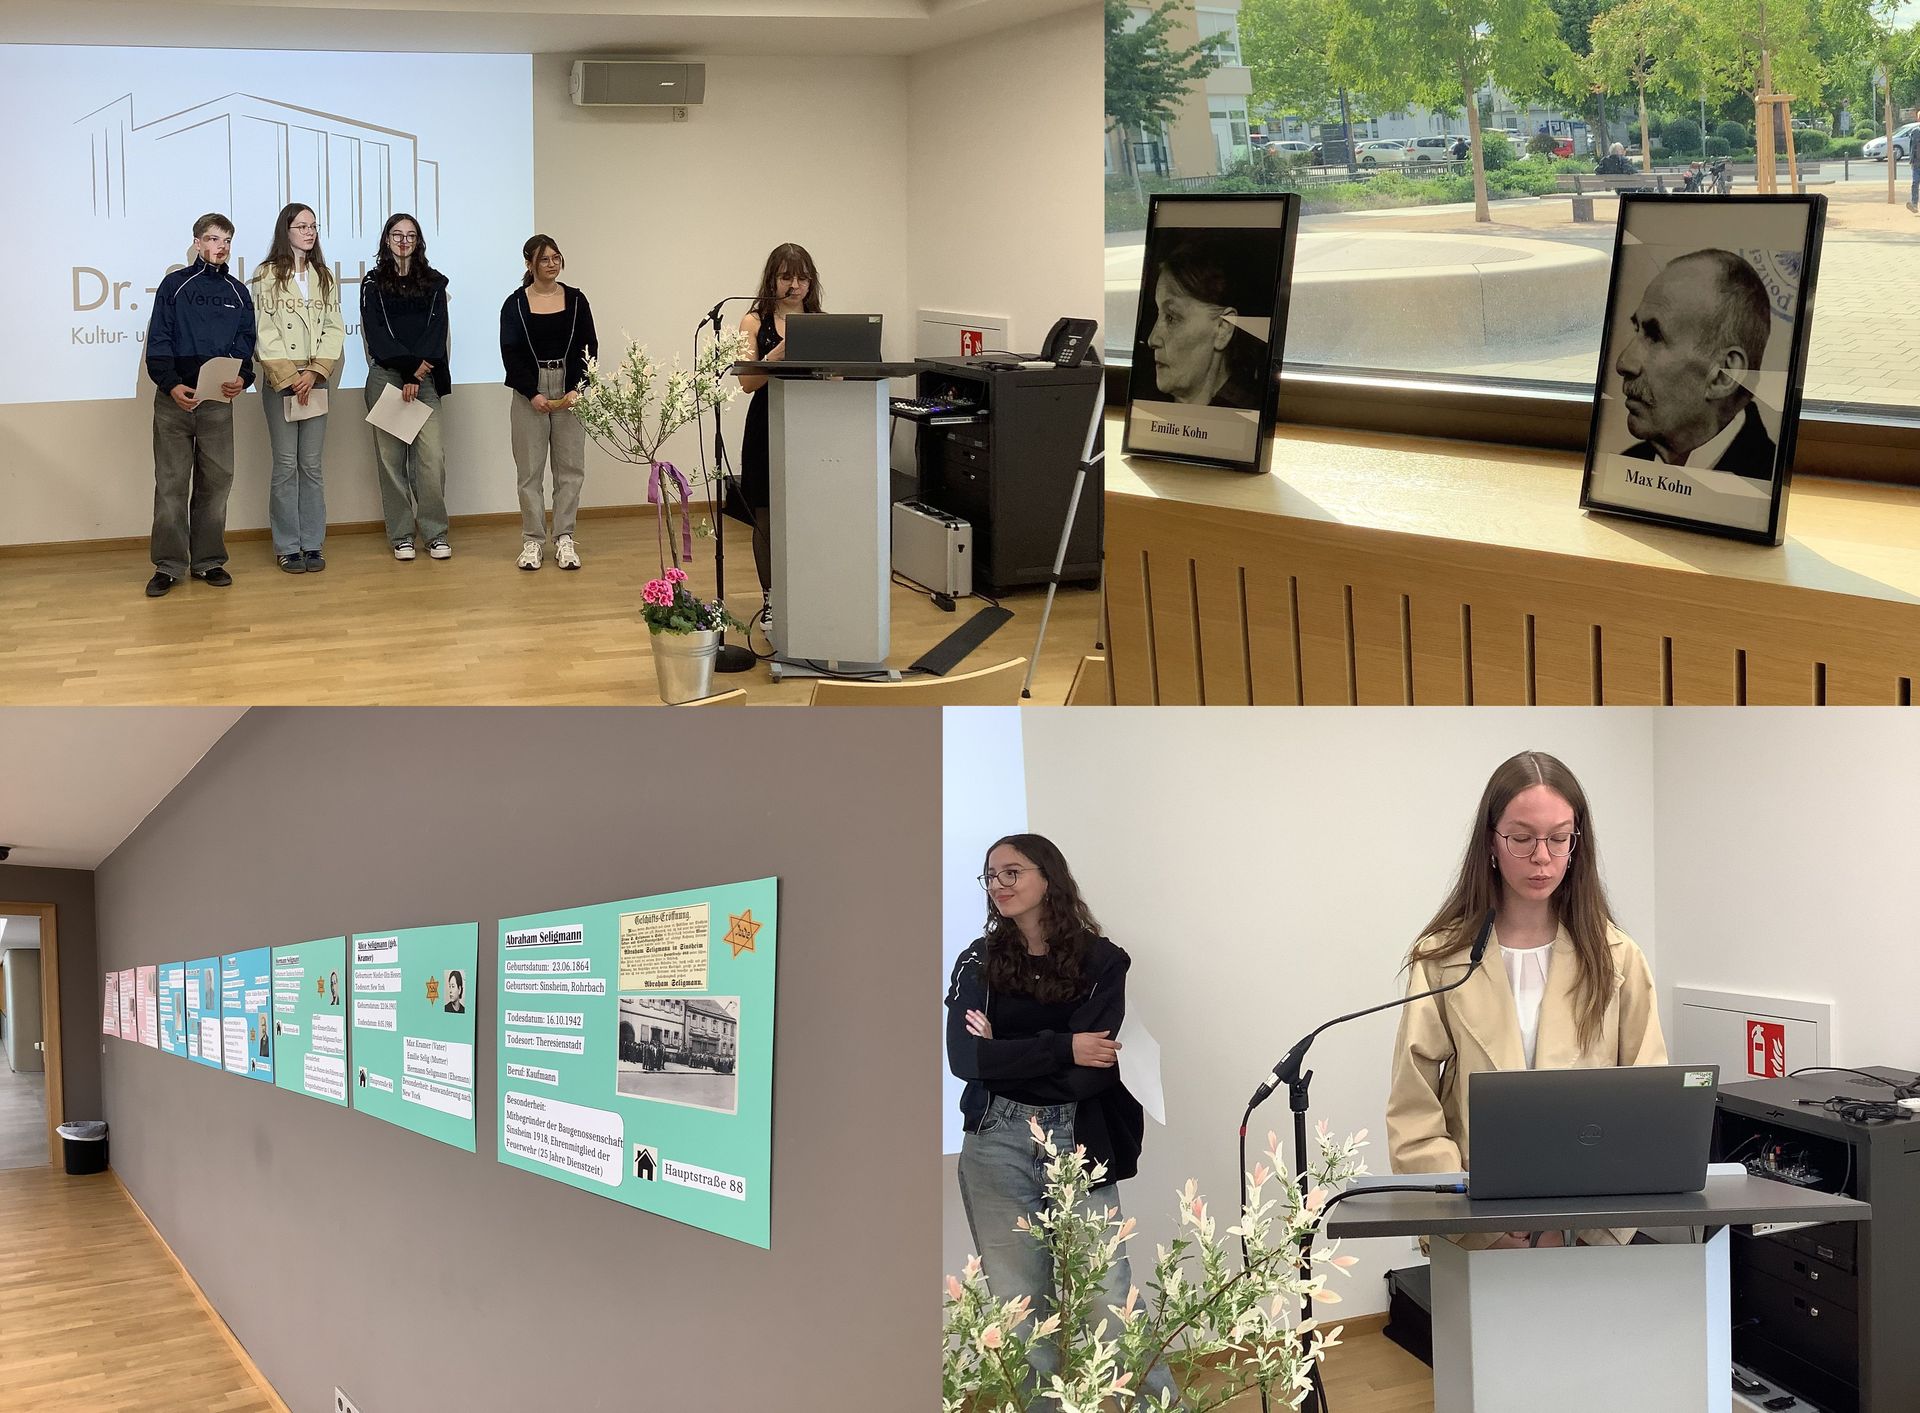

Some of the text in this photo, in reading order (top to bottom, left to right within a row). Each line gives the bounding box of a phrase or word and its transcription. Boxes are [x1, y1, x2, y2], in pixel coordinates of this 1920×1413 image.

[71, 325, 128, 345] Kultur-
[1150, 420, 1208, 440] Emilie Kohn
[1625, 468, 1692, 496] Max Kohn
[506, 931, 582, 945] Abraham Seligmann
[506, 961, 589, 972] Geburtsdatum: 23.06.1864
[506, 980, 604, 993] Geburtsort: Sinsheim, Rohrbach
[507, 1012, 581, 1026] Todesdatum: 16.10.1942
[507, 1034, 582, 1050] Todesort: Theresienstadt
[507, 1065, 556, 1082] Beruf: Kaufmann
[506, 1094, 547, 1112] Besonderheit:
[506, 1110, 624, 1149] Mitbegründer der Baugenossenschaft
[506, 1124, 611, 1162] Sinsheim 1918, Ehrenmitglied der
[506, 1138, 604, 1177] Feuerwehr (25 Jahre Dienstzeit)
[665, 1163, 743, 1193] Hauptstraße 88
